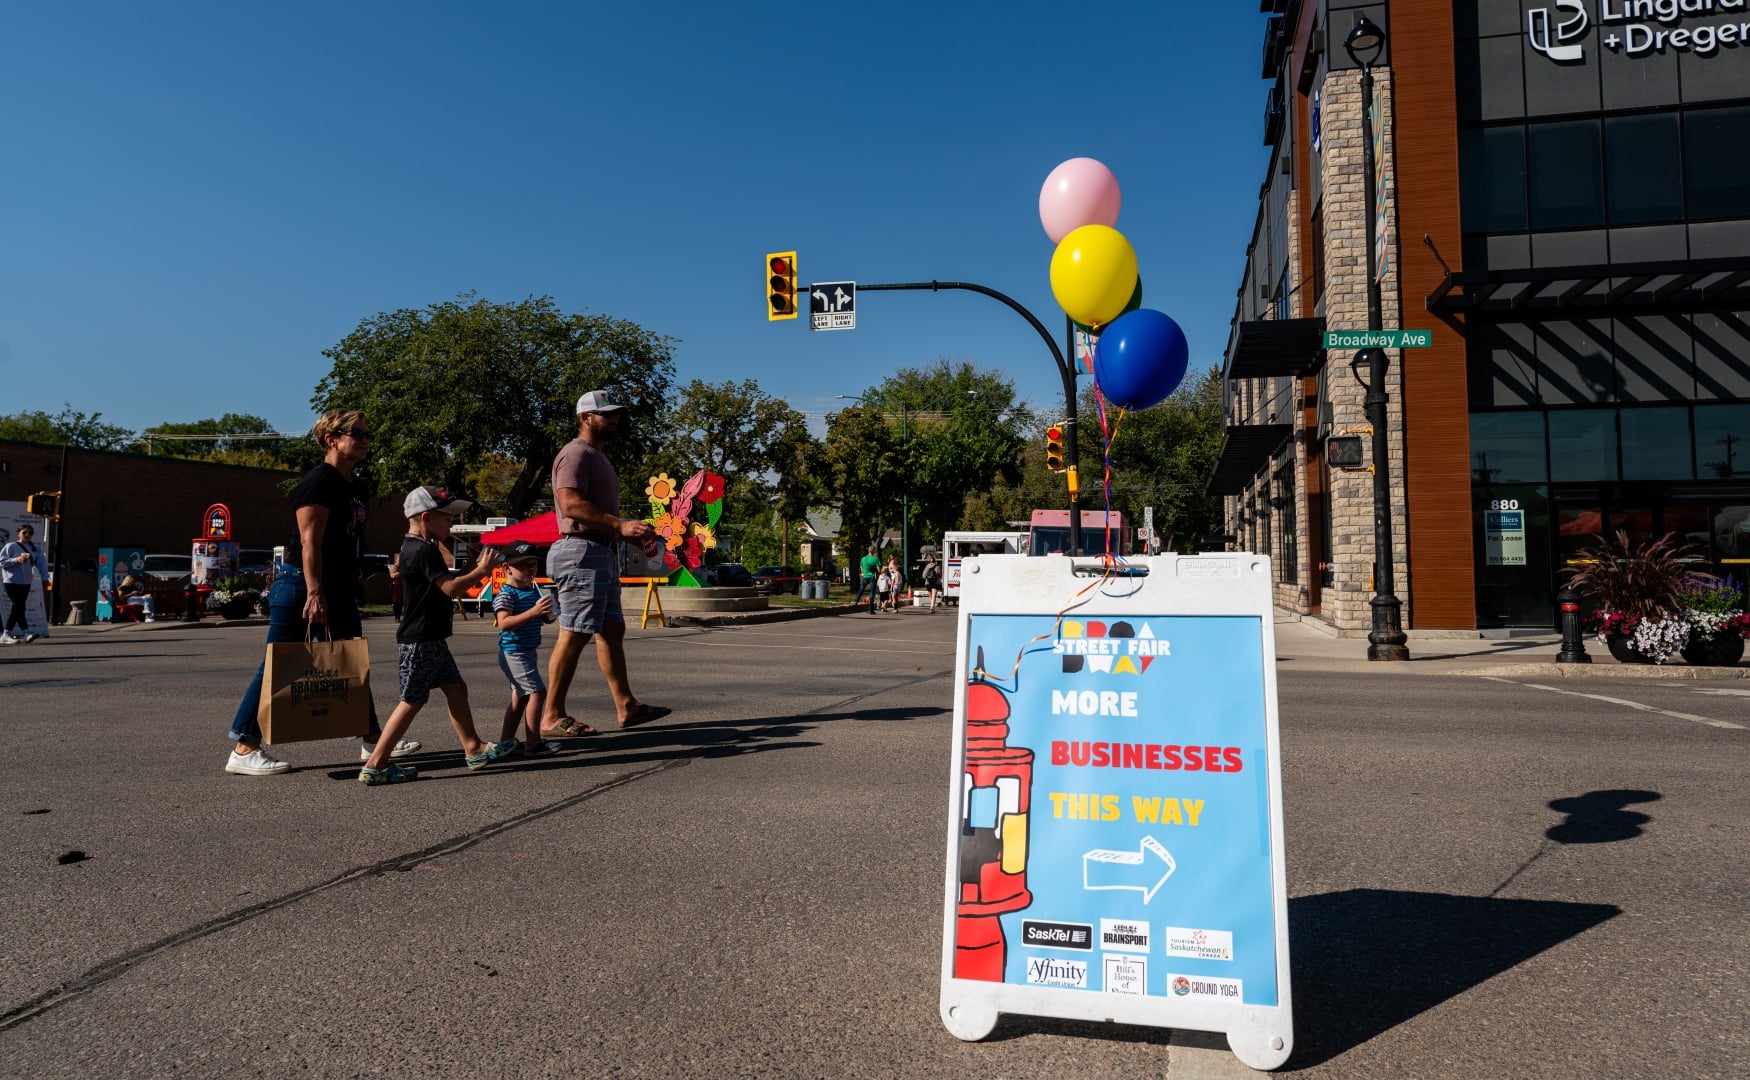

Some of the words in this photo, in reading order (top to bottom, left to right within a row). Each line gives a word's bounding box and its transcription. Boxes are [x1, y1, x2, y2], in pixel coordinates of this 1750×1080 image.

[1602, 0, 1744, 21] Linga
[1625, 22, 1750, 52] Dreger
[1328, 333, 1395, 347] Broadway
[1401, 332, 1426, 345] Ave
[1490, 499, 1519, 510] 880
[1052, 639, 1121, 655] STREET
[1128, 640, 1171, 656] FAIR
[1052, 690, 1138, 717] MORE
[1051, 741, 1243, 773] BUSINESSES
[1048, 792, 1121, 822] THIS
[1132, 796, 1205, 826] WAY
[1027, 927, 1071, 942] SaskTel
[1103, 932, 1148, 946] BRAINSPORT
[1169, 943, 1222, 954] Saskatchewan
[1028, 958, 1086, 985] Affinity
[1116, 965, 1136, 974] Bill's
[1121, 981, 1130, 989] of
[1191, 981, 1218, 996] GROUND
[1219, 984, 1239, 997] YOGA
